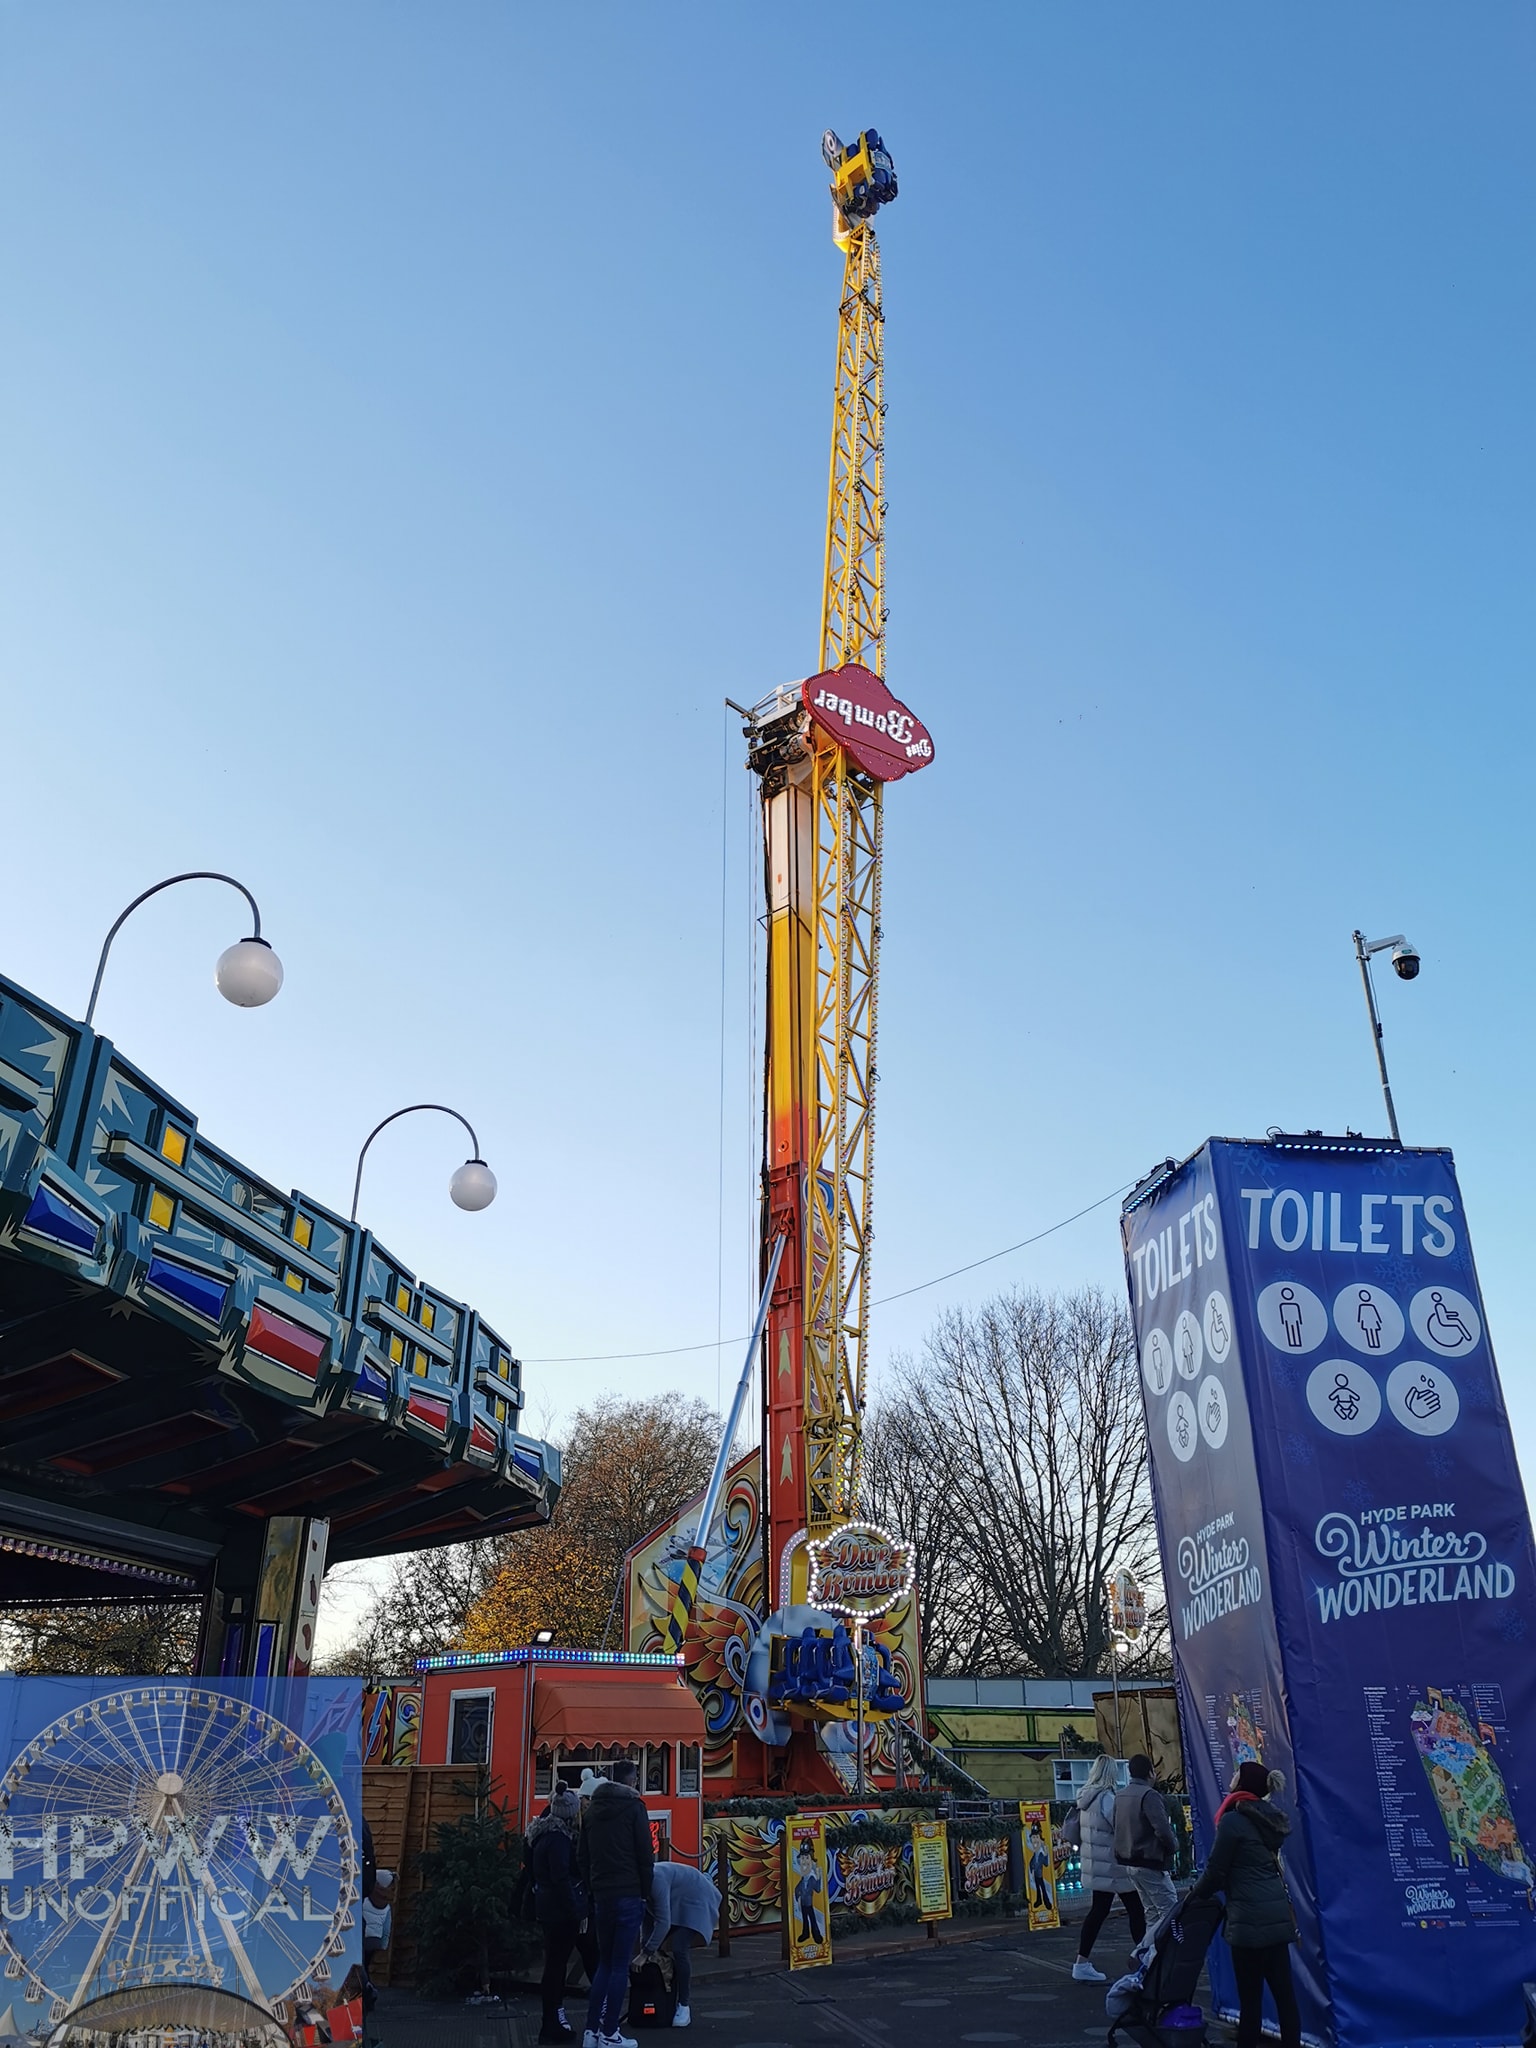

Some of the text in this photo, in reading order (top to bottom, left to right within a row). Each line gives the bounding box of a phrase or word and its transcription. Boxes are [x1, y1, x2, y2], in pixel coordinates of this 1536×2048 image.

[812, 688, 915, 745] Bomber
[1132, 1191, 1217, 1308] TOILETS
[1240, 1188, 1456, 1259] TOILETS
[1196, 1511, 1235, 1546] HYDE PARK
[1315, 1512, 1487, 1578] Winter
[1360, 1502, 1456, 1527] HYDE PARK
[829, 1534, 892, 1571] Dive
[1177, 1535, 1250, 1596] Winter
[813, 1565, 909, 1604] Bomber
[1181, 1564, 1263, 1641] WONDERLAND
[1318, 1562, 1516, 1625] WONDERLAND
